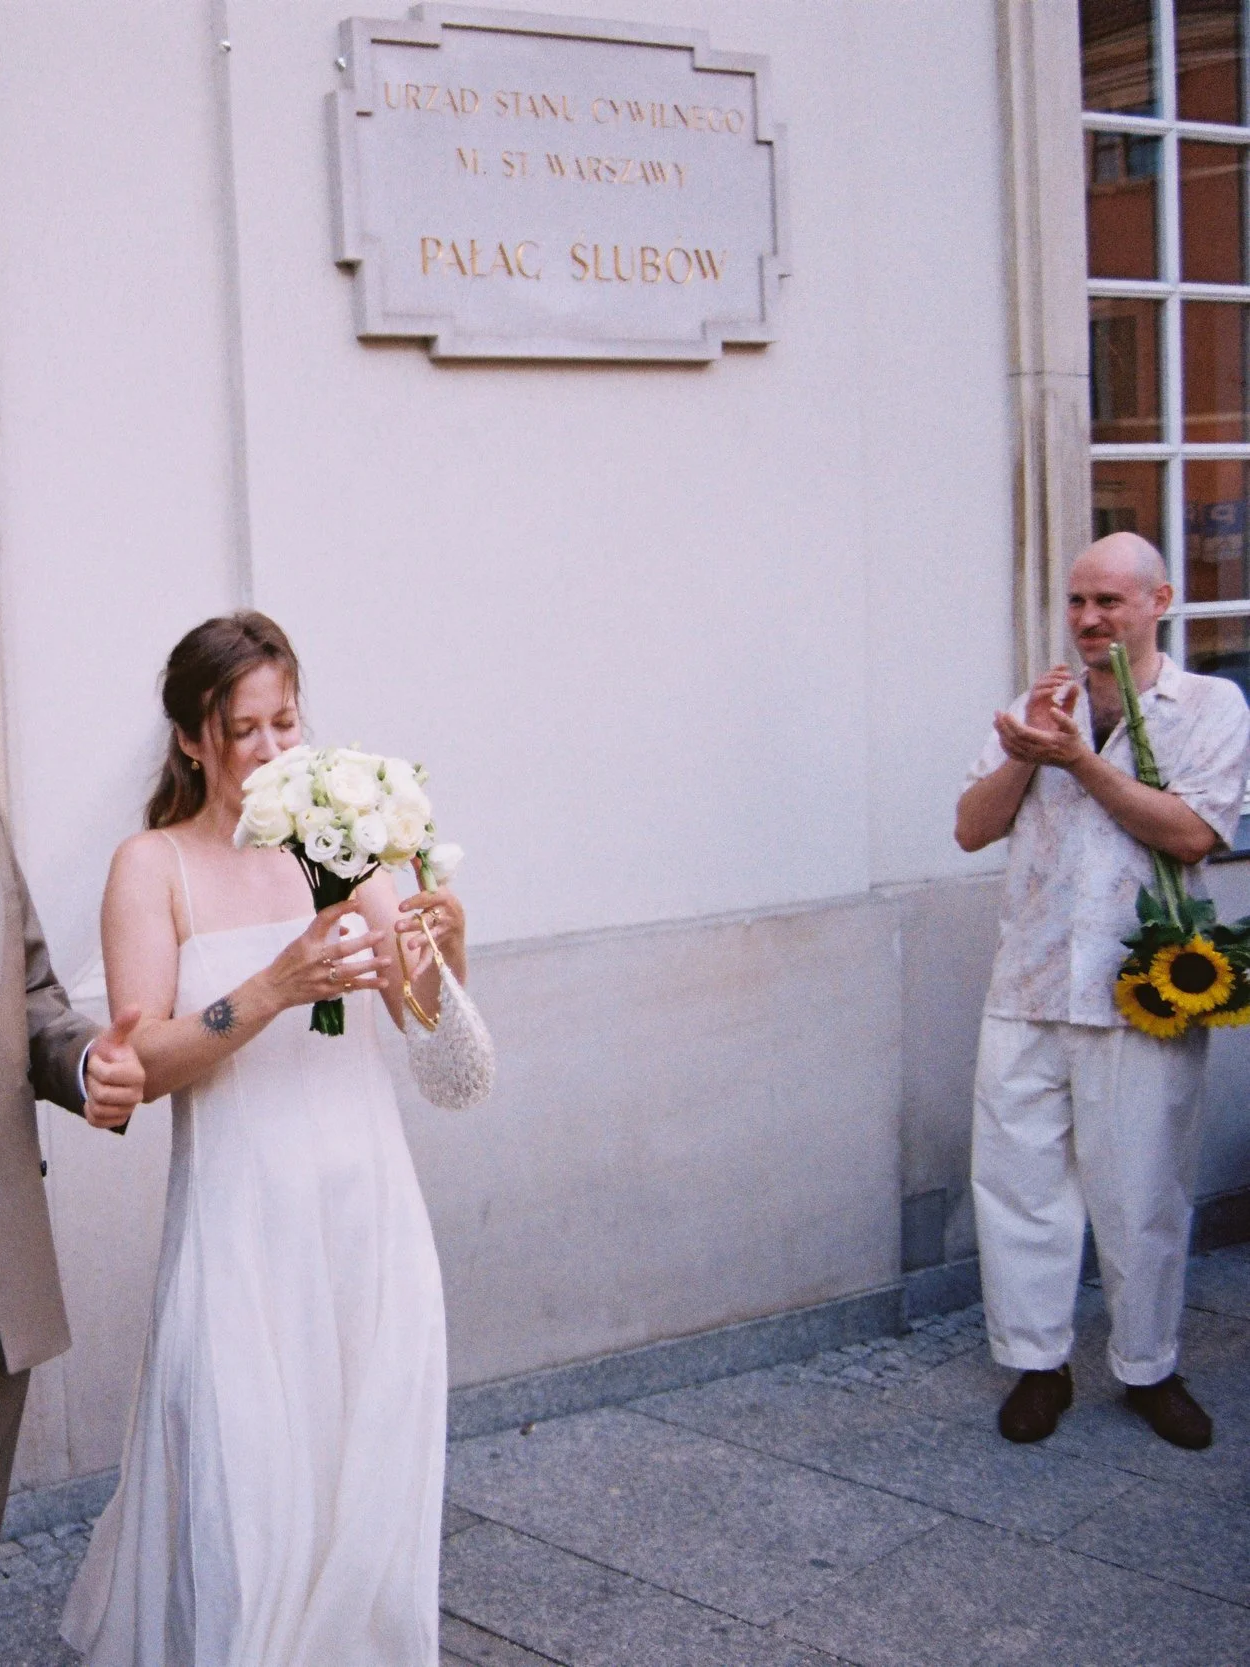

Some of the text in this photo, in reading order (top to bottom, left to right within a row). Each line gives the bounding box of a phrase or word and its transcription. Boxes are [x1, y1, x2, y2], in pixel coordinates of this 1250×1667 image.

[494, 90, 575, 123] STANU
[591, 97, 745, 135] CYWILNEGO
[546, 151, 688, 188] WARSZAWY
[420, 237, 541, 281] PAŁAC
